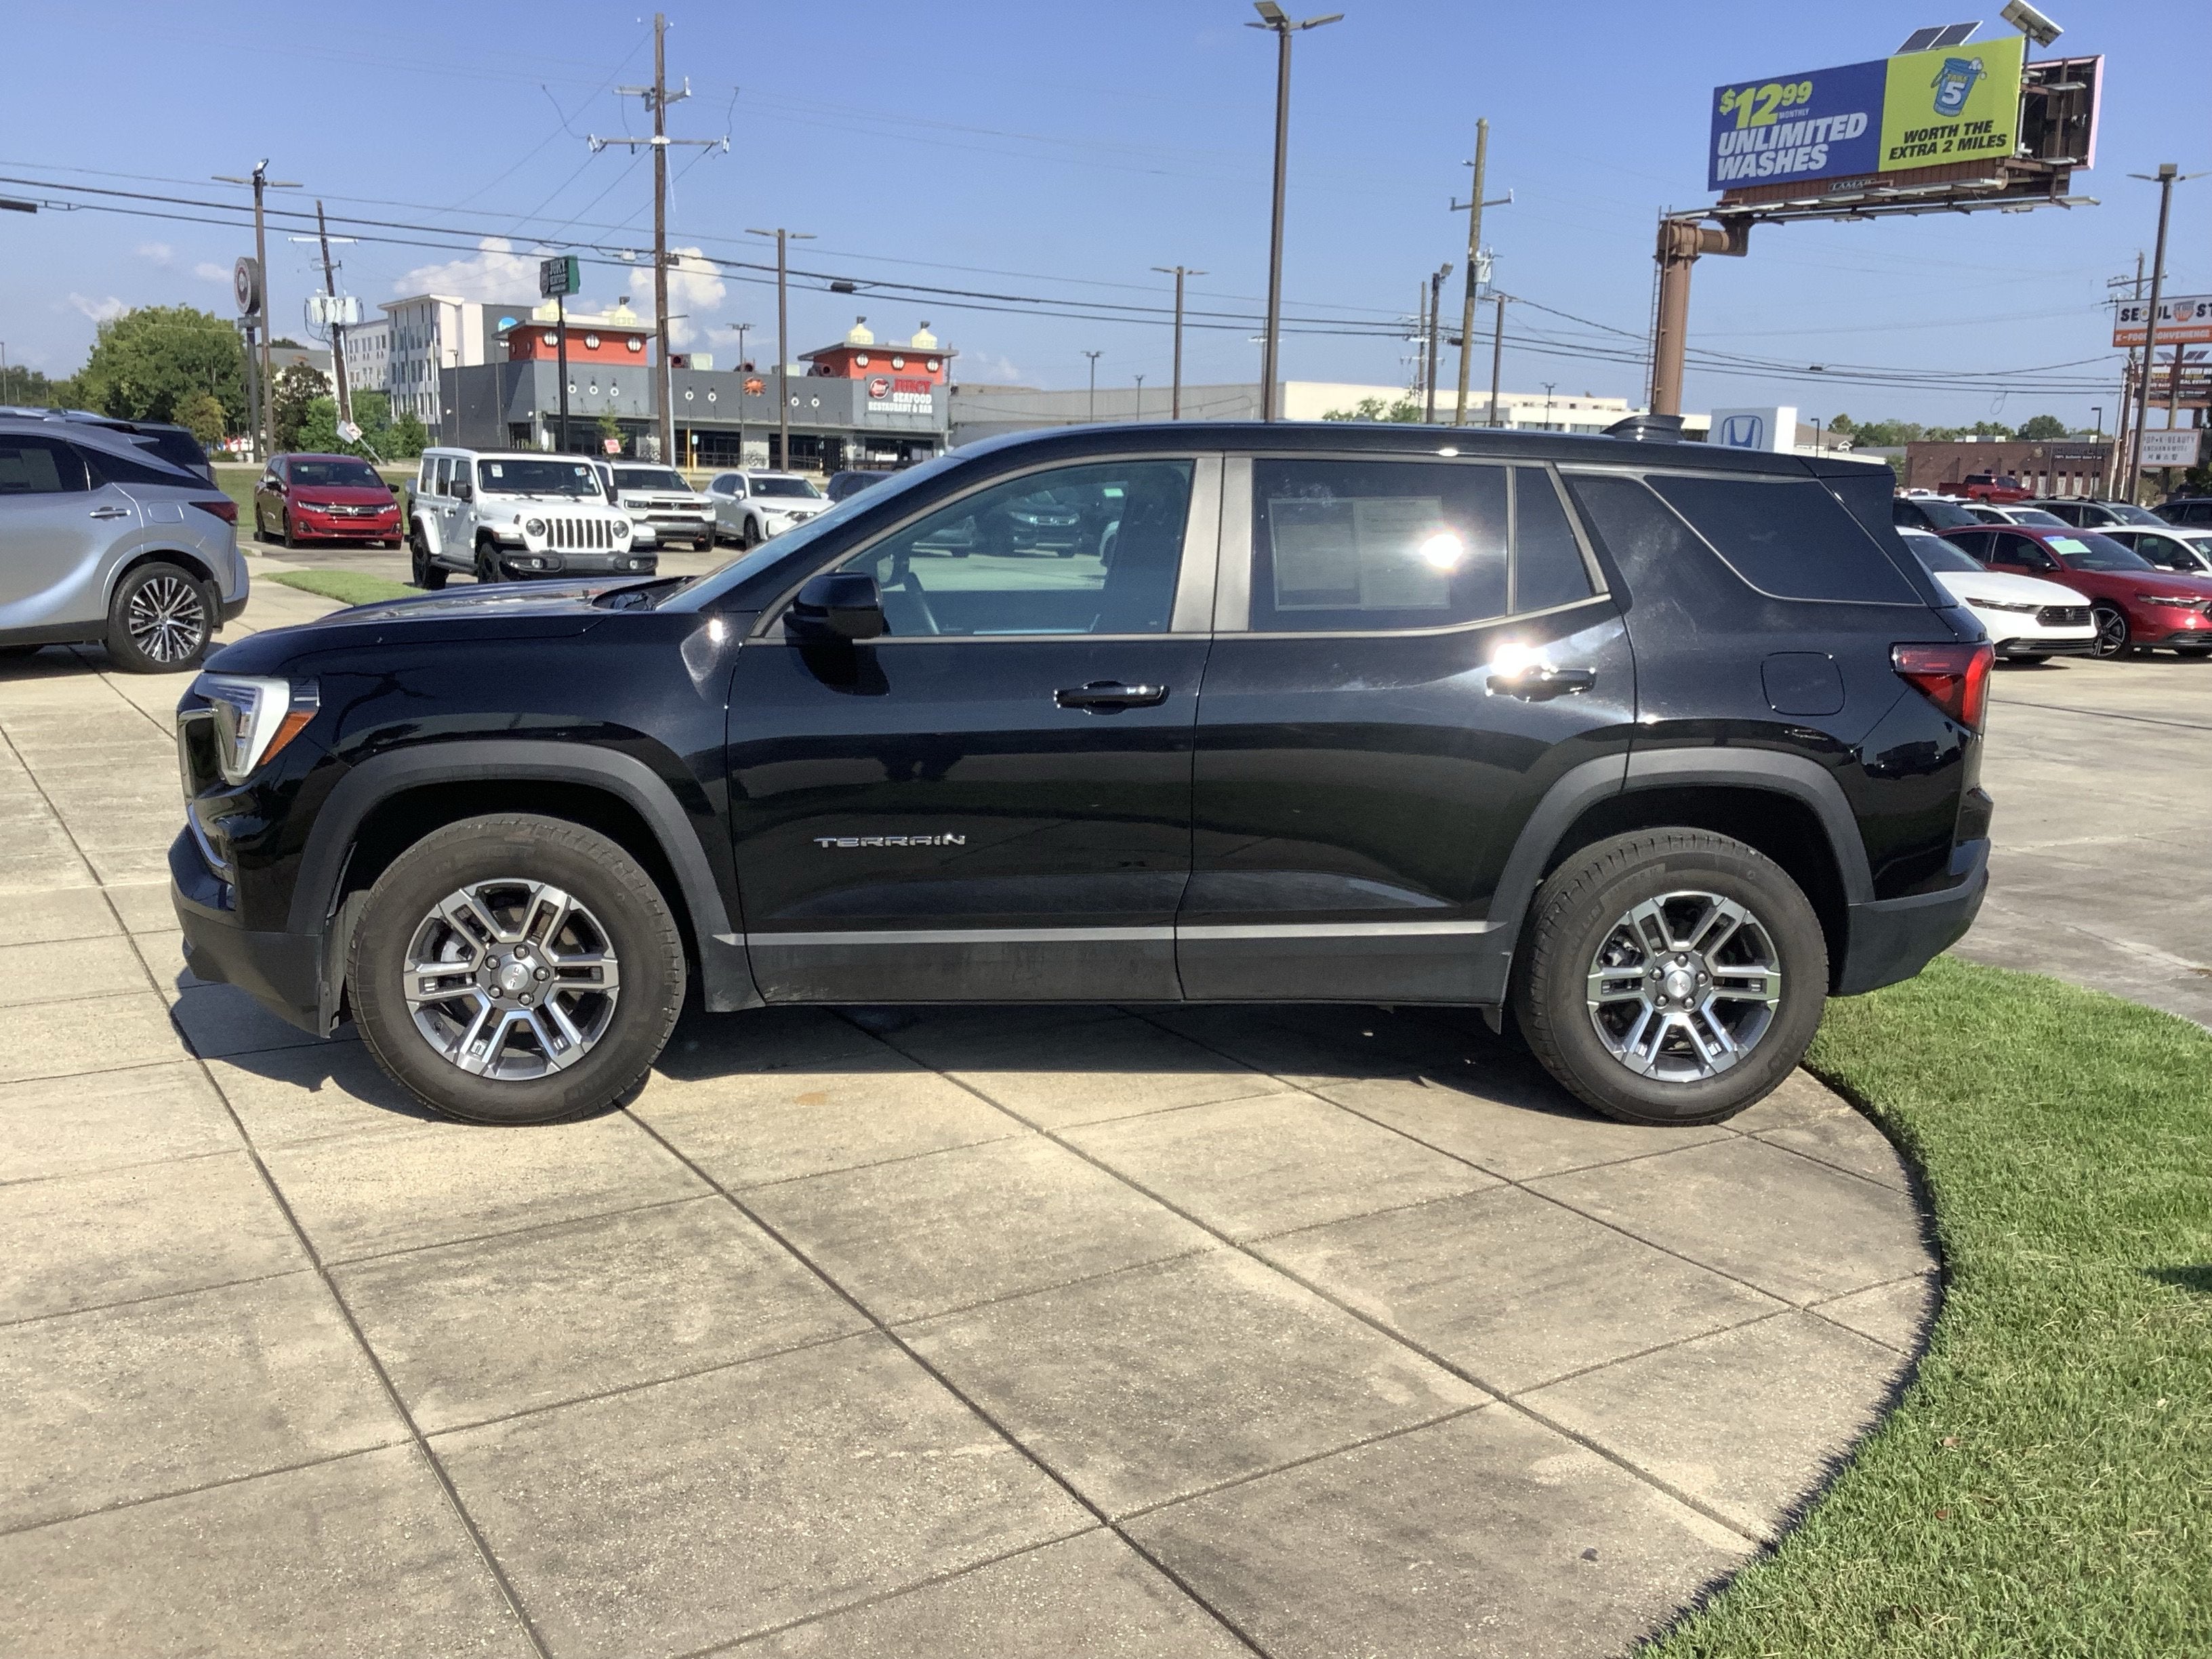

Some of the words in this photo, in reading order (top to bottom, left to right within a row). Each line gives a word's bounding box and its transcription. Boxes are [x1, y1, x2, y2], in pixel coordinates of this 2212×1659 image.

[1942, 81, 1965, 105] 5
[1779, 108, 1810, 120] MONTHLY
[1717, 112, 1868, 157] UNLIMITED
[1903, 124, 1960, 144] WORTH
[1963, 119, 1994, 136] THE
[1889, 142, 1938, 161] EXTRA
[1942, 140, 1953, 153] 2
[1957, 134, 2007, 151] MILES
[1717, 143, 1828, 182] WASHES
[892, 379, 932, 394] JUICY
[868, 401, 912, 413] RESTAURANT
[919, 405, 933, 413] BAR
[893, 392, 933, 405] SEAFOOD
[813, 835, 965, 848] TERRAIN
